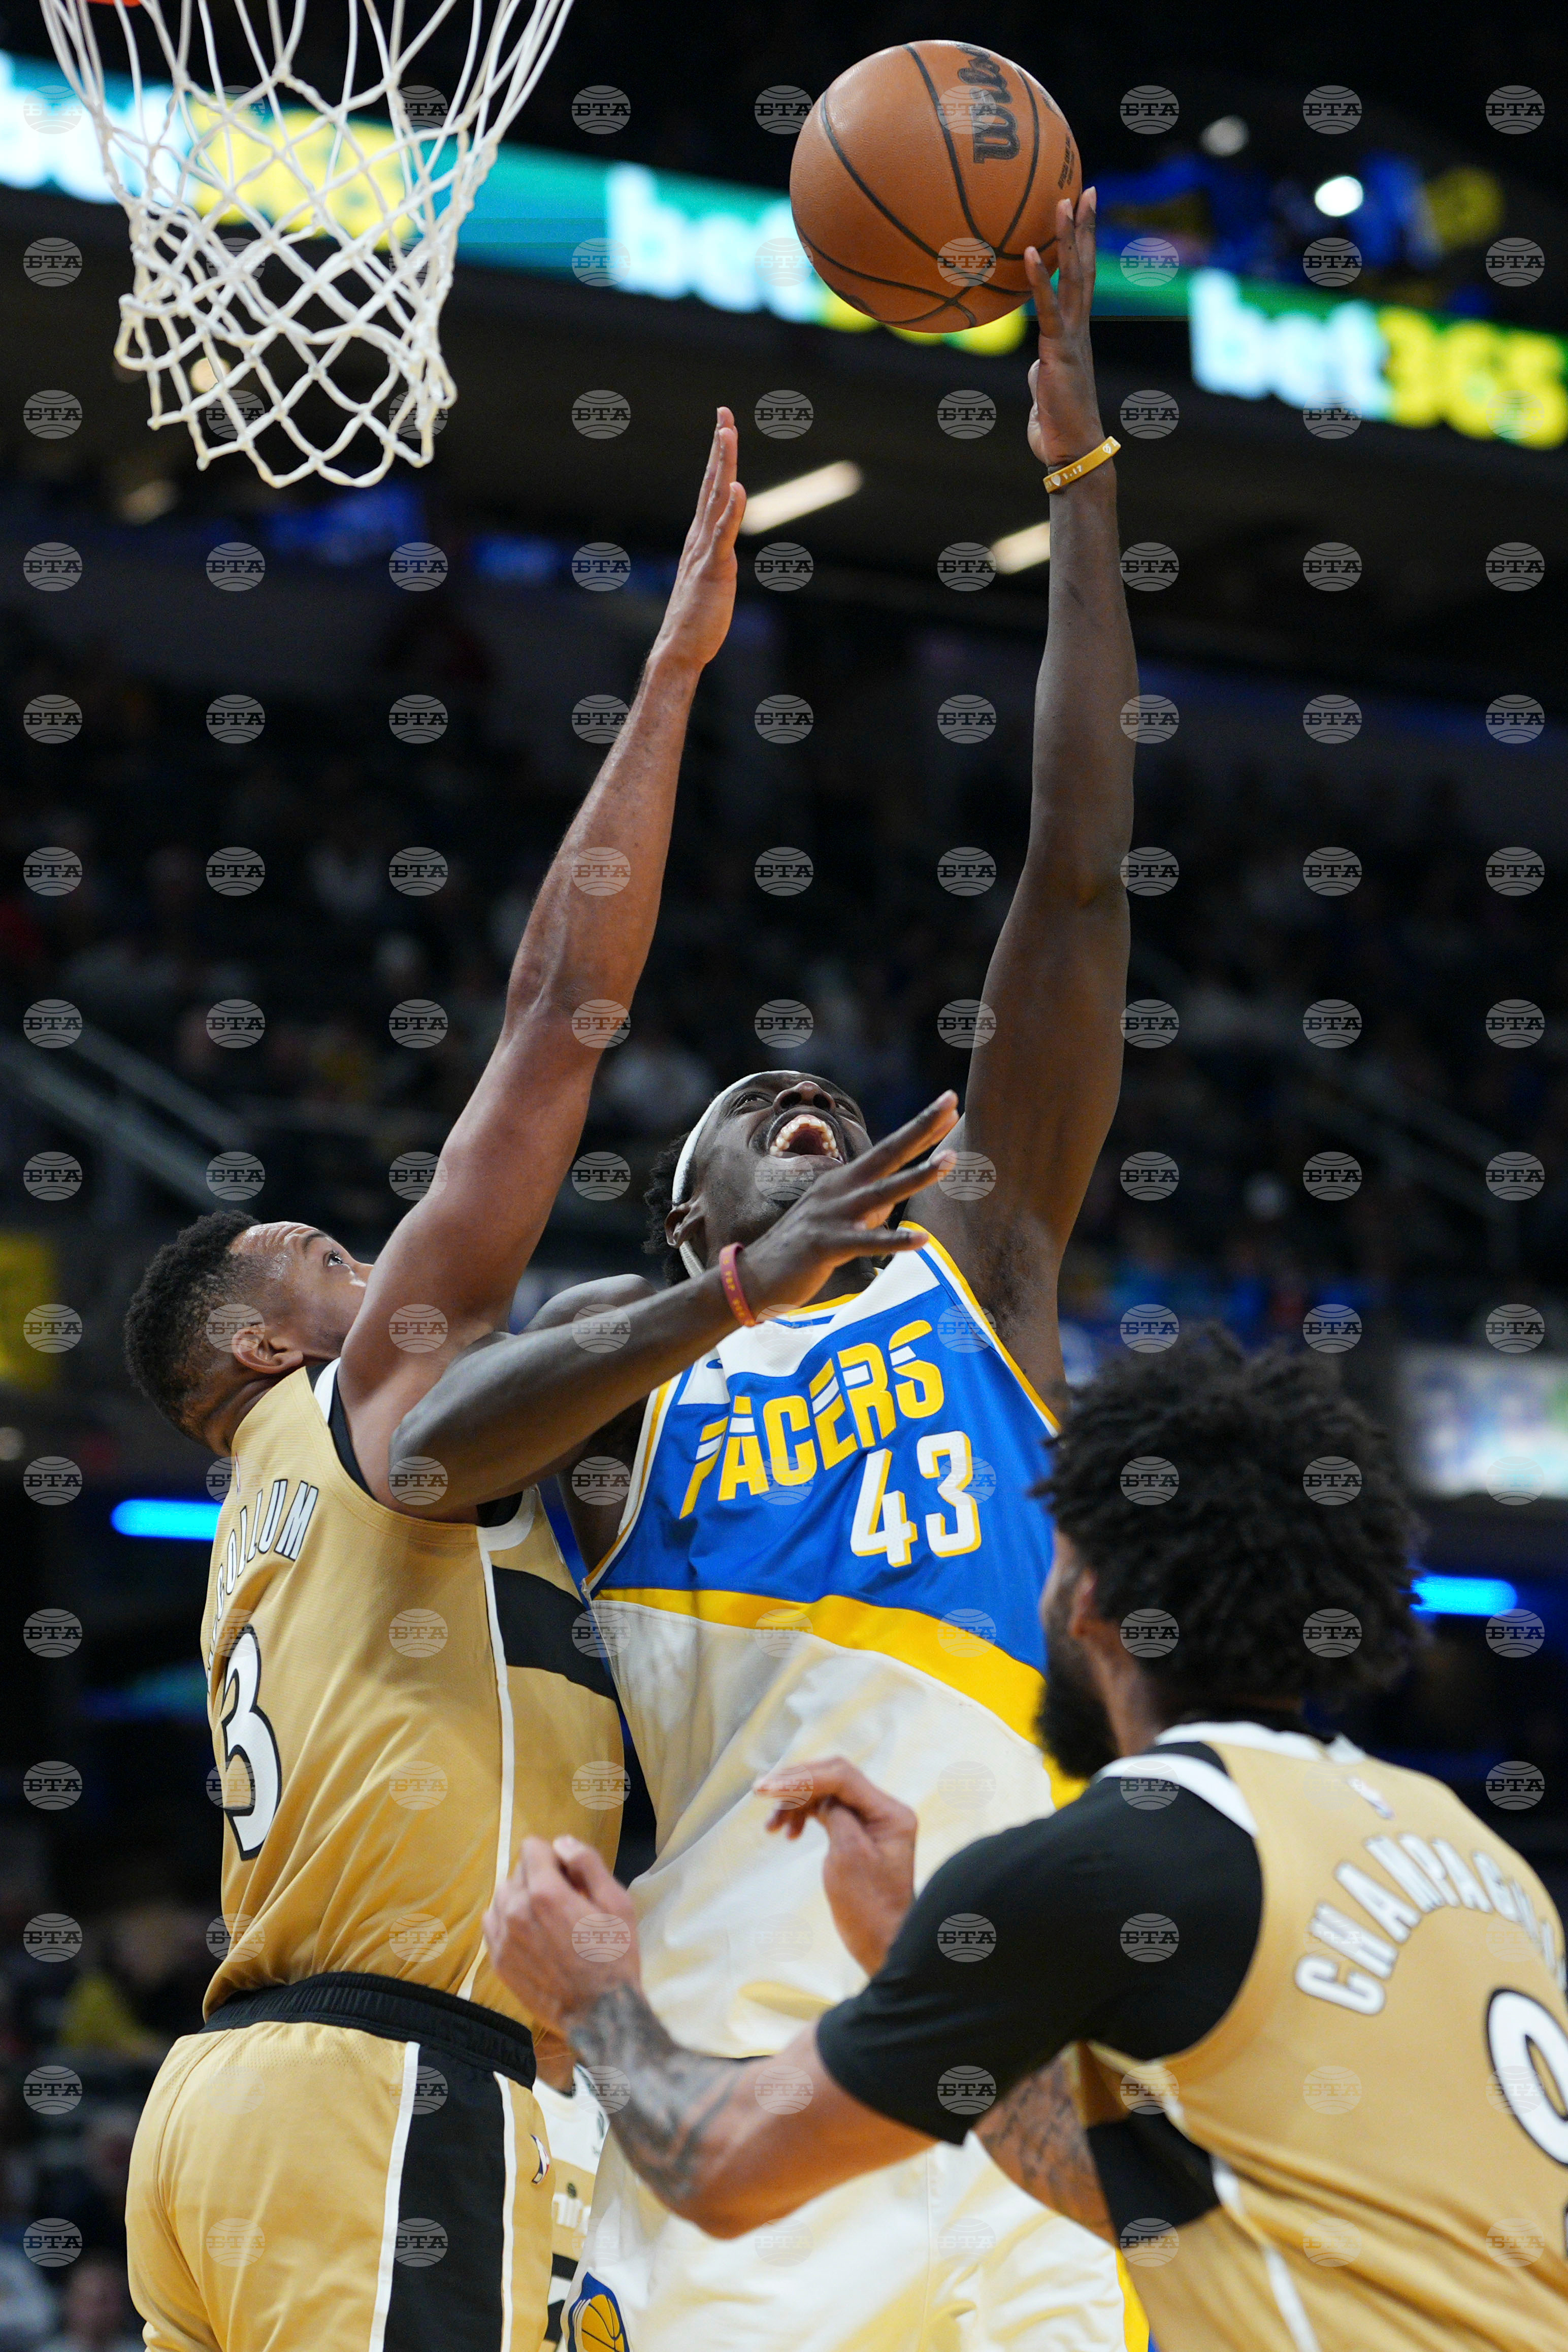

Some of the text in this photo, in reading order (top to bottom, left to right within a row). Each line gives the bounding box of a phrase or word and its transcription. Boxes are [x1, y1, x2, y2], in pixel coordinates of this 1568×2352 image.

[679, 1320, 944, 1519] PACERS
[851, 1430, 982, 1567] 43
[220, 1622, 282, 1860] 3
